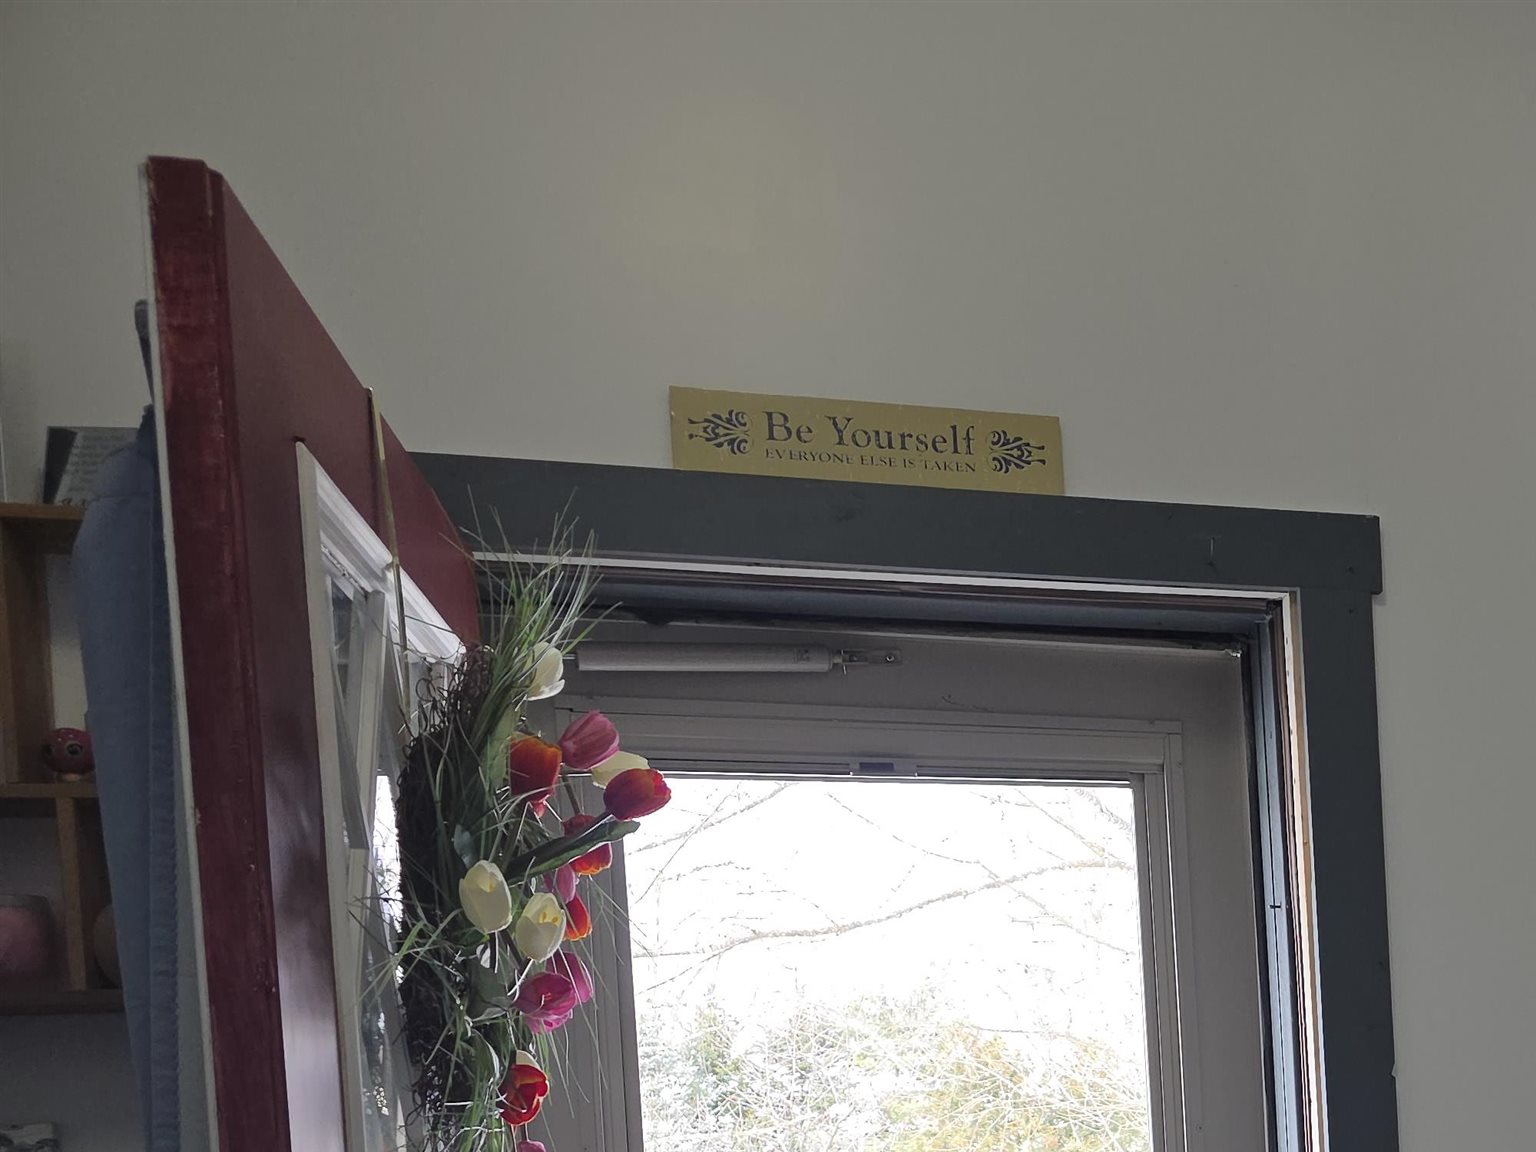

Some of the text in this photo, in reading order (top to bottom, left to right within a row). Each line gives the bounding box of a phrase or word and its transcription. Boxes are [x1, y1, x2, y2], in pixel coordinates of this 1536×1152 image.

[763, 411, 975, 455] Be Yourself
[765, 448, 977, 473] EVERYONE ELSE IS TAKEN
